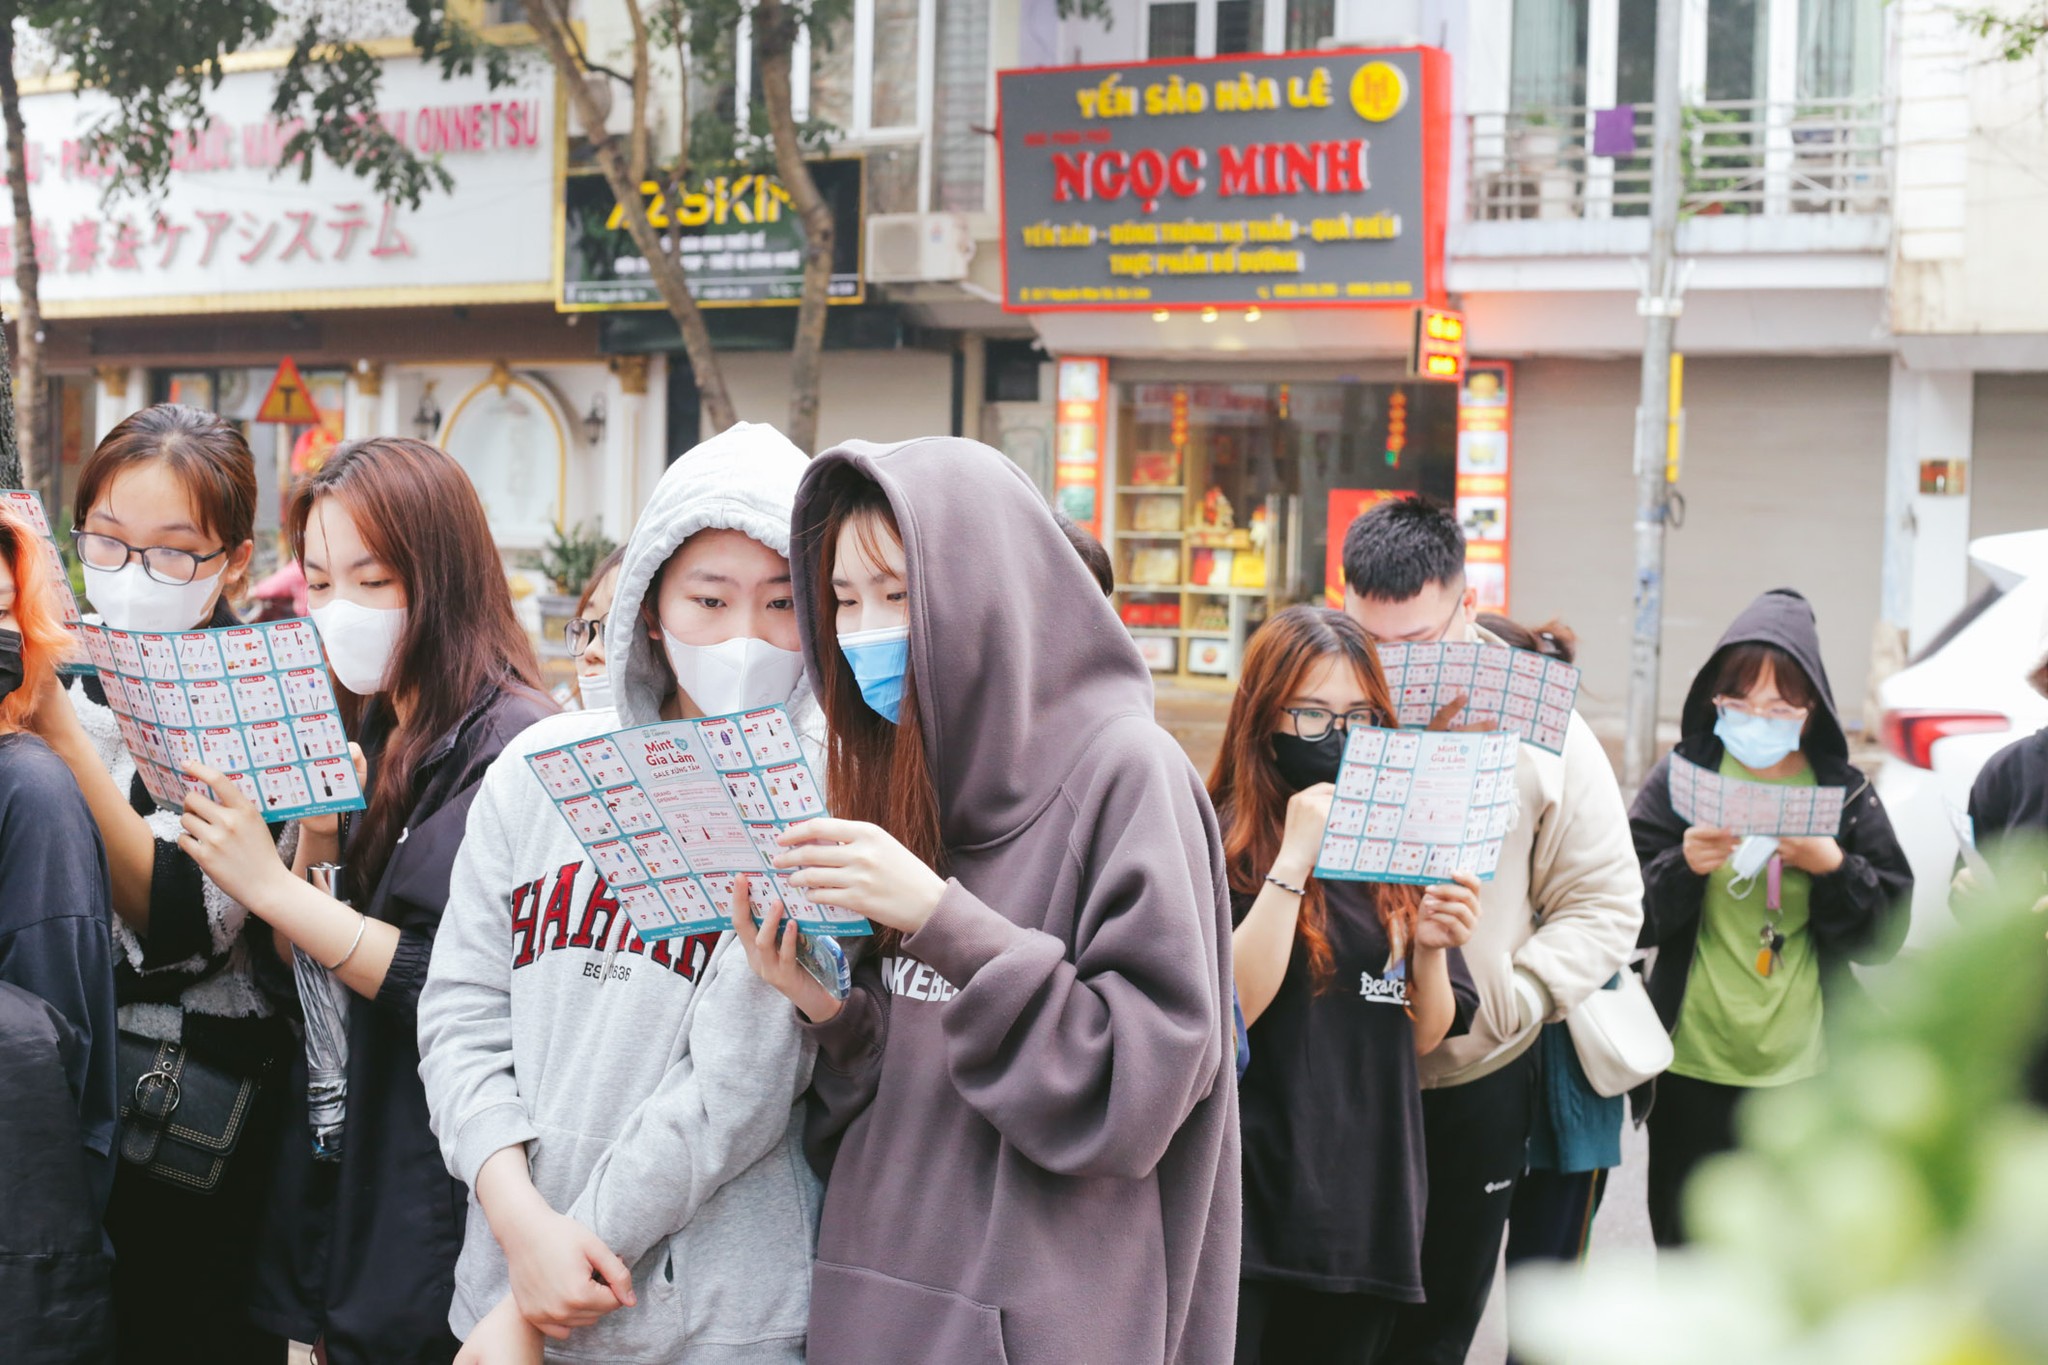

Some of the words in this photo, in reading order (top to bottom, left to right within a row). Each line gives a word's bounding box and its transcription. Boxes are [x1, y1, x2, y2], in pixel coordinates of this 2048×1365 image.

[416, 97, 539, 153] ONNETSU
[1052, 146, 1207, 213] NGỌC
[1217, 138, 1370, 197] MINH
[644, 739, 674, 754] Mint
[645, 753, 668, 766] Gia
[668, 751, 696, 764] Lâm
[653, 769, 670, 779] SALE
[582, 961, 606, 981] ES
